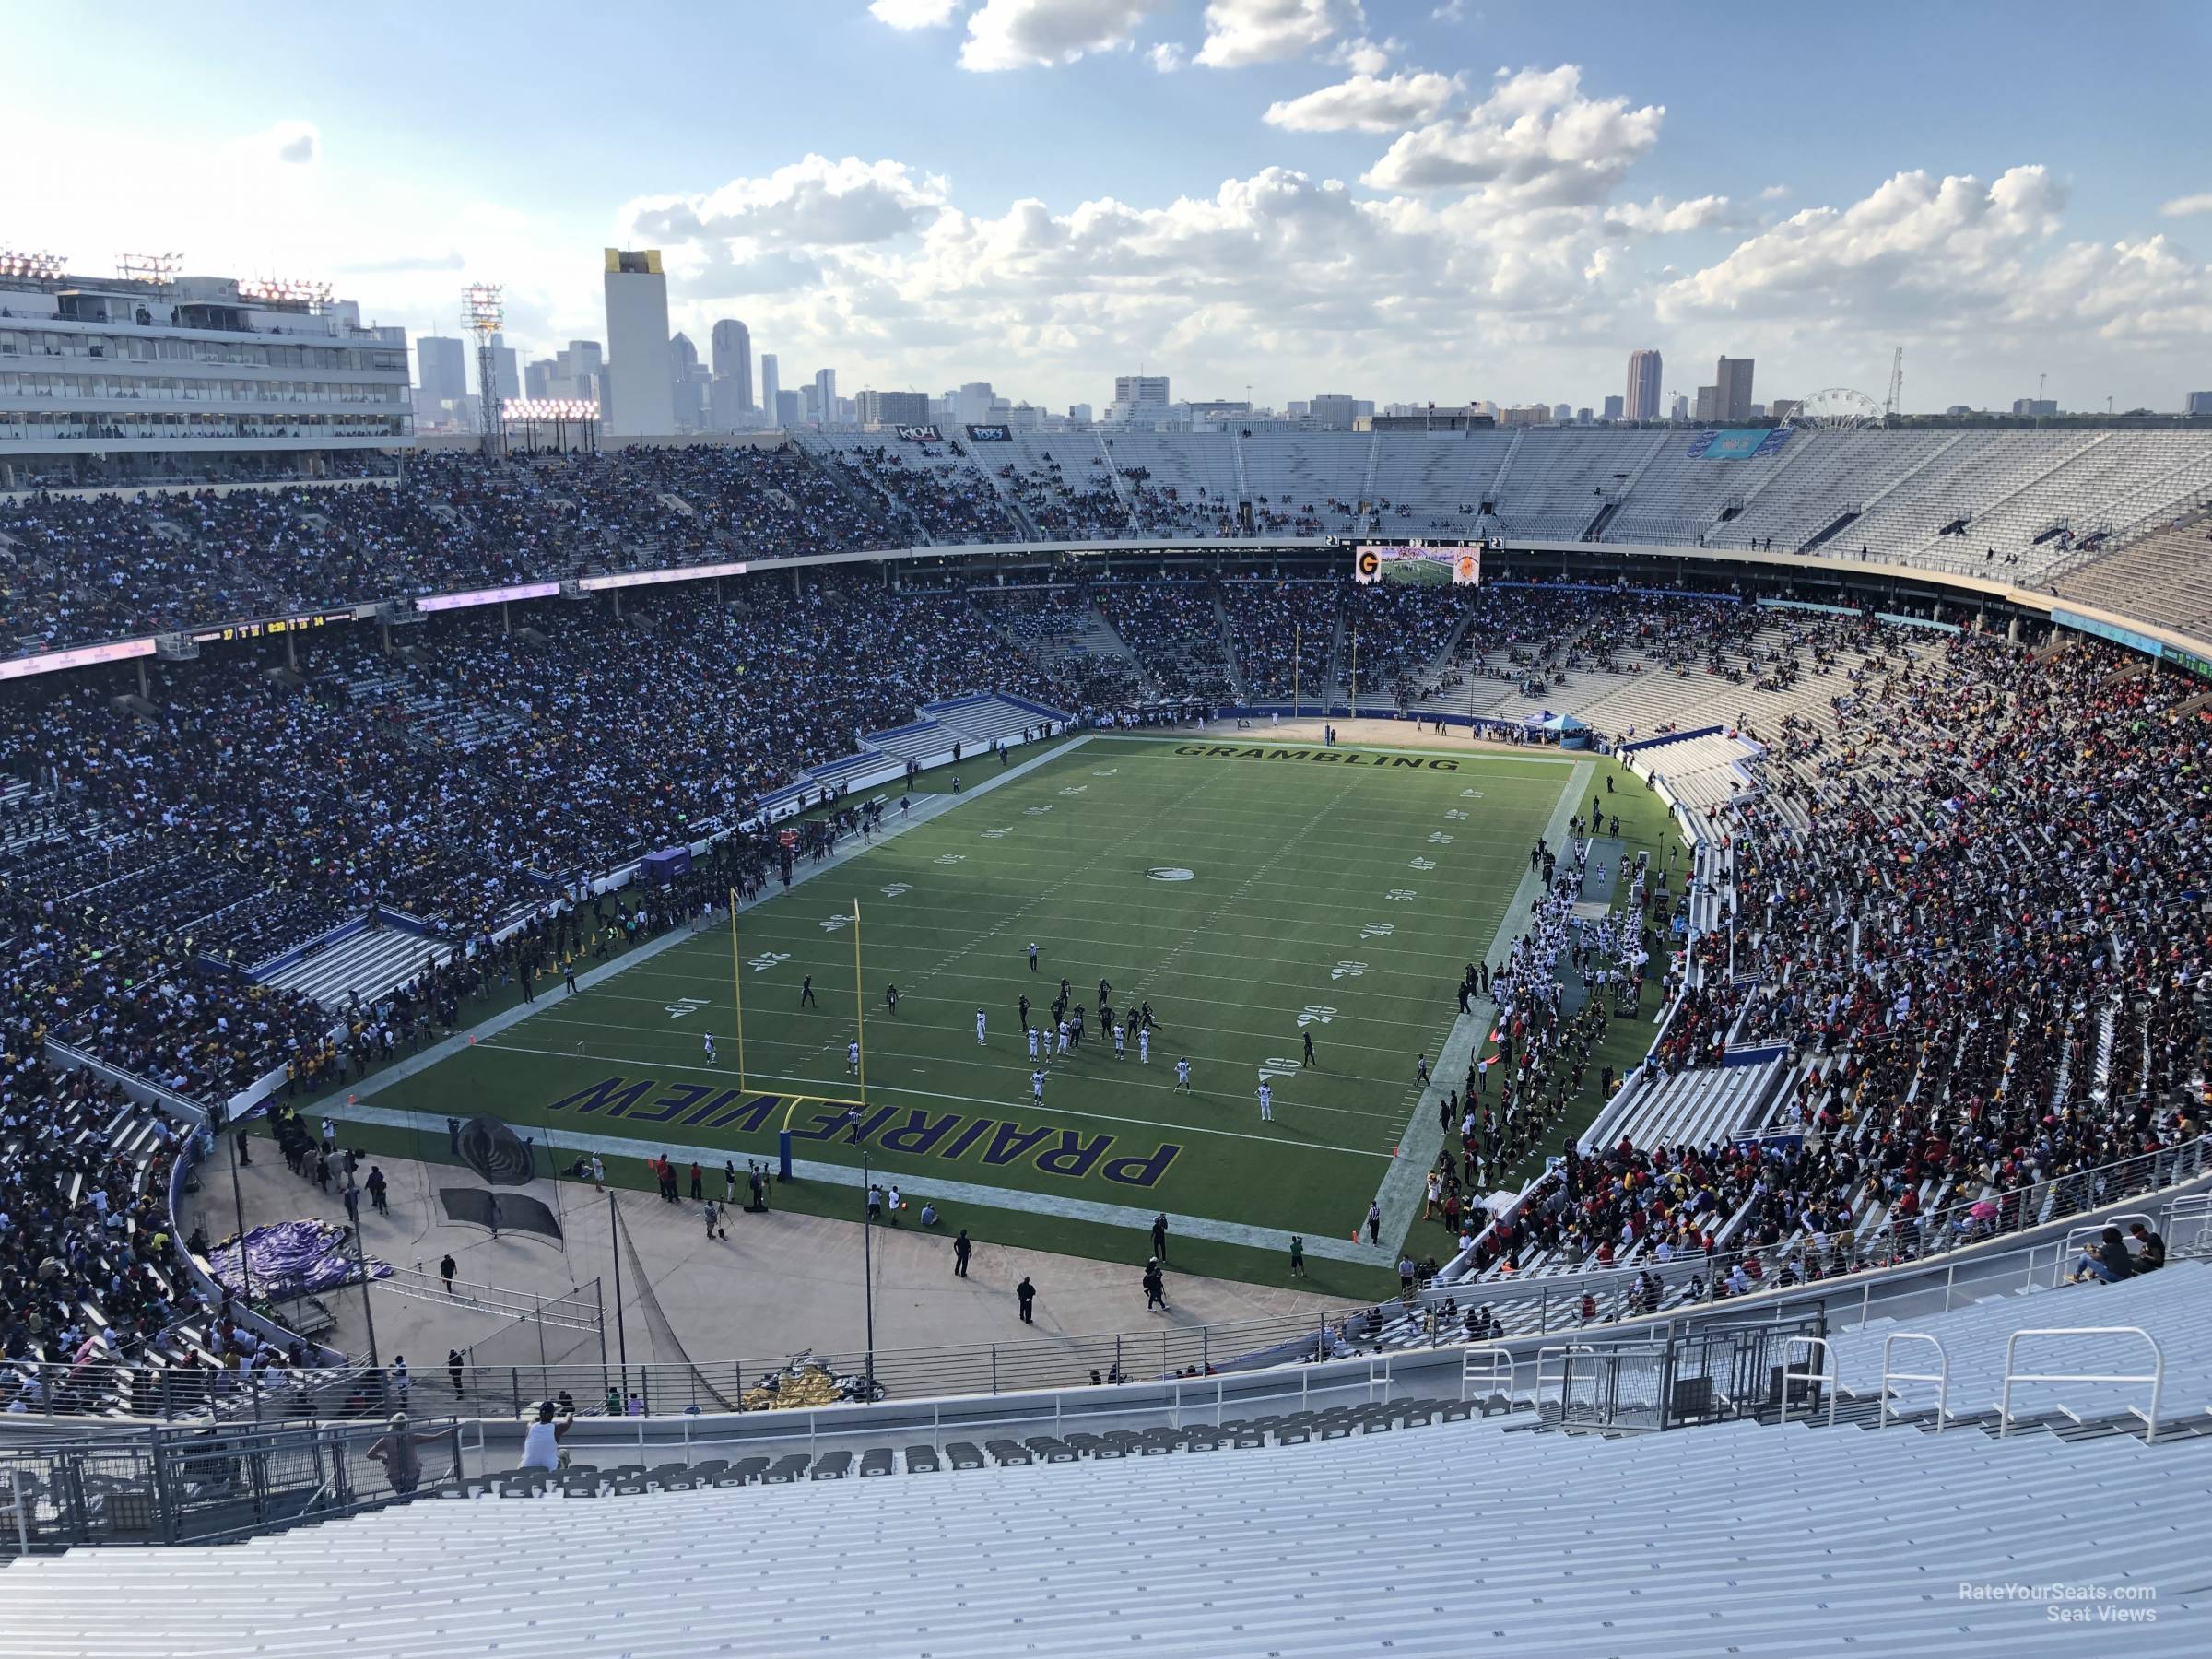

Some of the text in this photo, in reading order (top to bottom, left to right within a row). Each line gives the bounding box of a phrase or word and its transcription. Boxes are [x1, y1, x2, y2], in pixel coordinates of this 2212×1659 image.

[1174, 746, 1460, 771] GRAMBLING
[933, 853, 966, 864] 50
[1408, 859, 1436, 871] 40
[1385, 888, 1417, 901] 50
[1361, 922, 1394, 935] 40
[747, 951, 791, 967] 20
[1331, 960, 1369, 976] 30
[664, 997, 712, 1013] 10
[1297, 1005, 1339, 1024] 20
[1258, 1057, 1302, 1077] 10
[547, 1076, 1184, 1188] PRAIRIE VIEW
